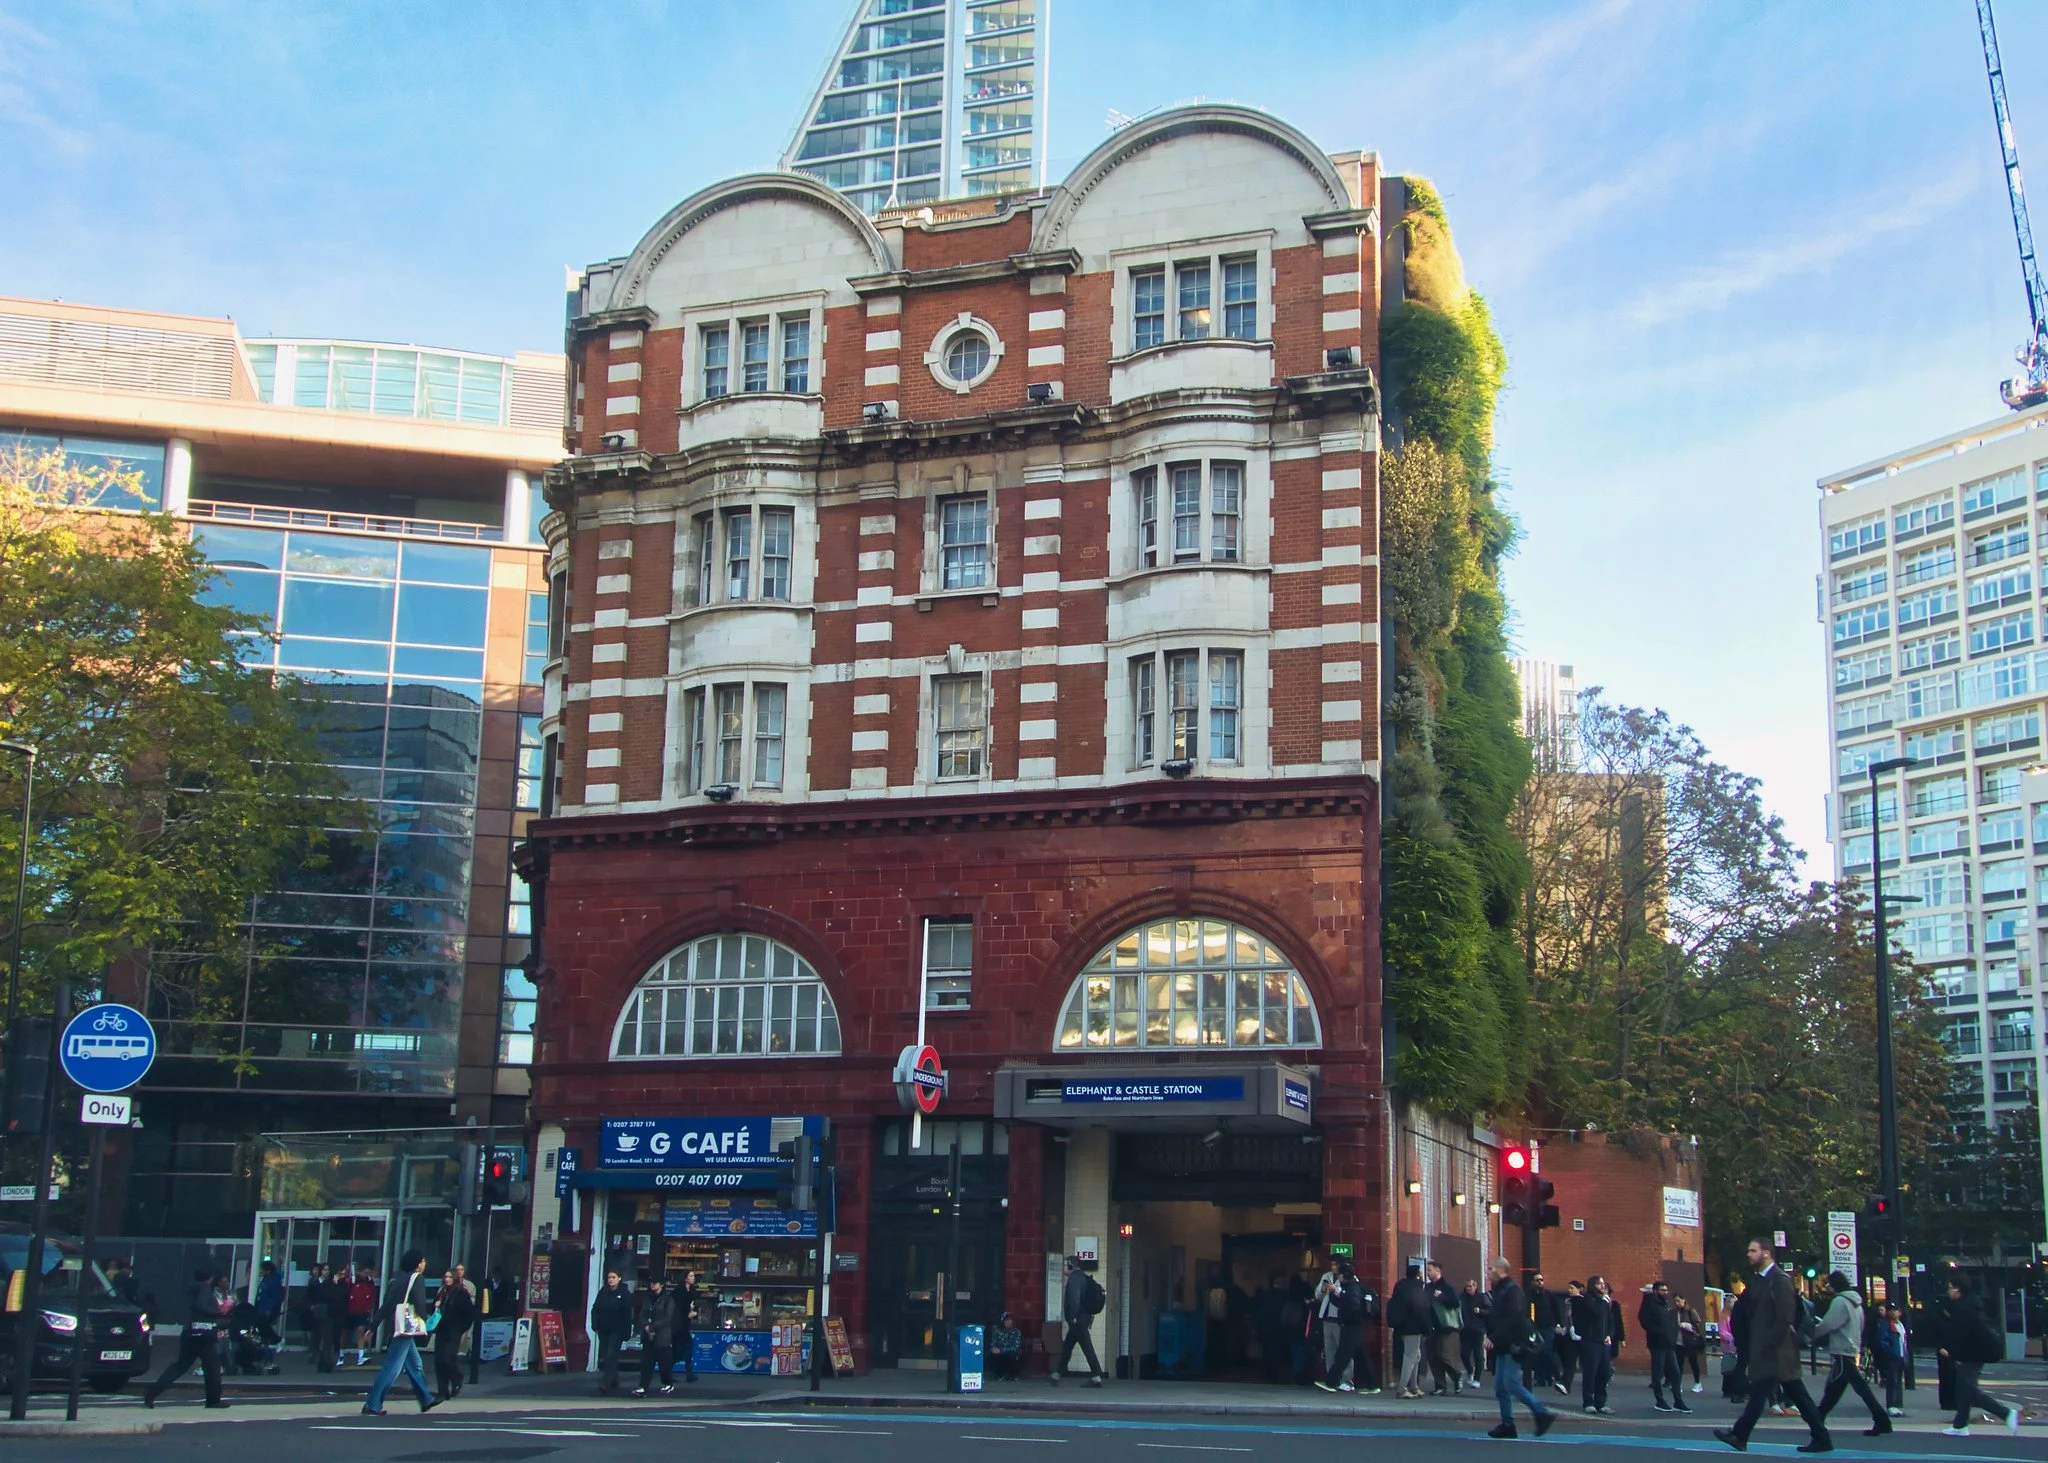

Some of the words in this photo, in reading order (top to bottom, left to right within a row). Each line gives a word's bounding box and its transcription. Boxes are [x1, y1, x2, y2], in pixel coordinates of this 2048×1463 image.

[914, 1072, 944, 1086] UNDERGROUND
[1066, 1086, 1112, 1095] ELEPHANT
[1115, 1086, 1122, 1095] &
[1125, 1086, 1160, 1094] CASTLE
[1163, 1085, 1202, 1094] STATION
[89, 1101, 125, 1118] Only
[650, 1132, 671, 1155] G
[681, 1125, 750, 1154] CAFÉ
[566, 1151, 572, 1161] G
[561, 1160, 576, 1171] CAFÉ
[655, 1174, 684, 1186] 0207
[688, 1174, 709, 1186] 407
[714, 1174, 744, 1186] 0107
[2, 1187, 31, 1196] LONDON
[1076, 1251, 1094, 1259] LFB
[721, 1333, 738, 1343] Coffee
[738, 1334, 743, 1342] &
[743, 1334, 755, 1342] Tea
